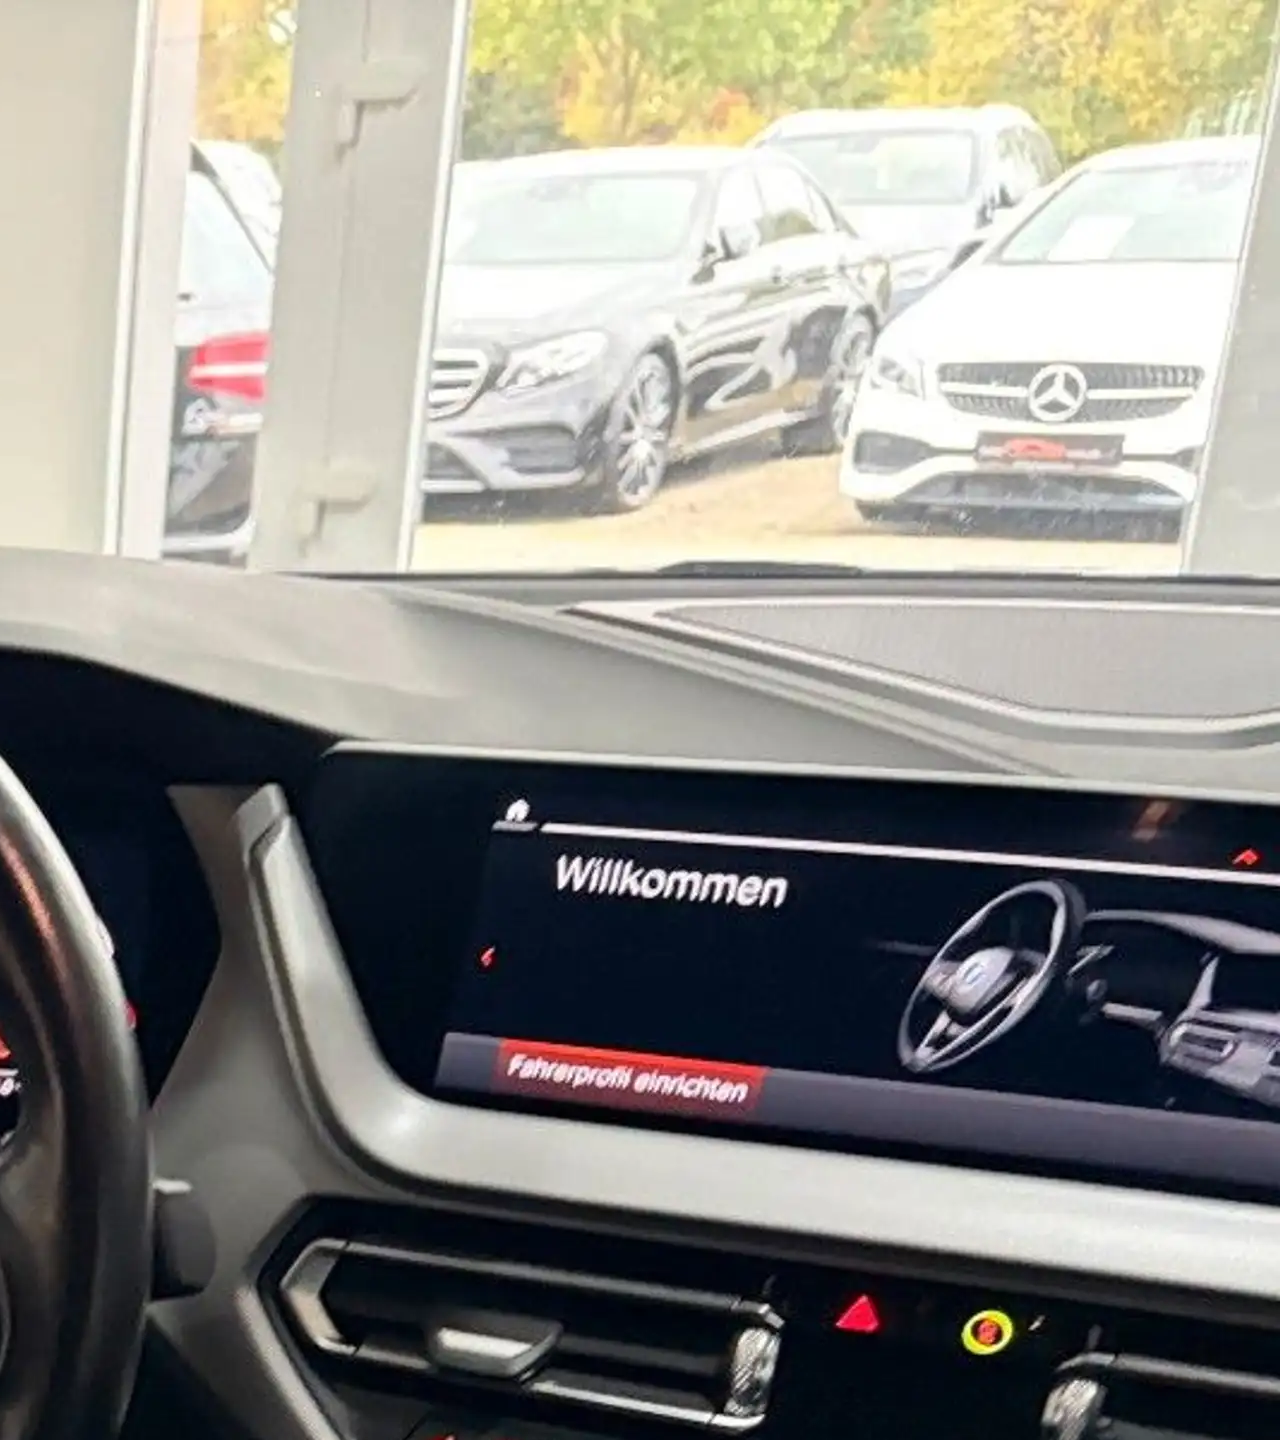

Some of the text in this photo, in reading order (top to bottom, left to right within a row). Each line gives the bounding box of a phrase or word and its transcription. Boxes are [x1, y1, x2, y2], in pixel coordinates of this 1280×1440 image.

[556, 854, 788, 908] Willkommen
[507, 1053, 749, 1103] Fahrerprofil einrichten
